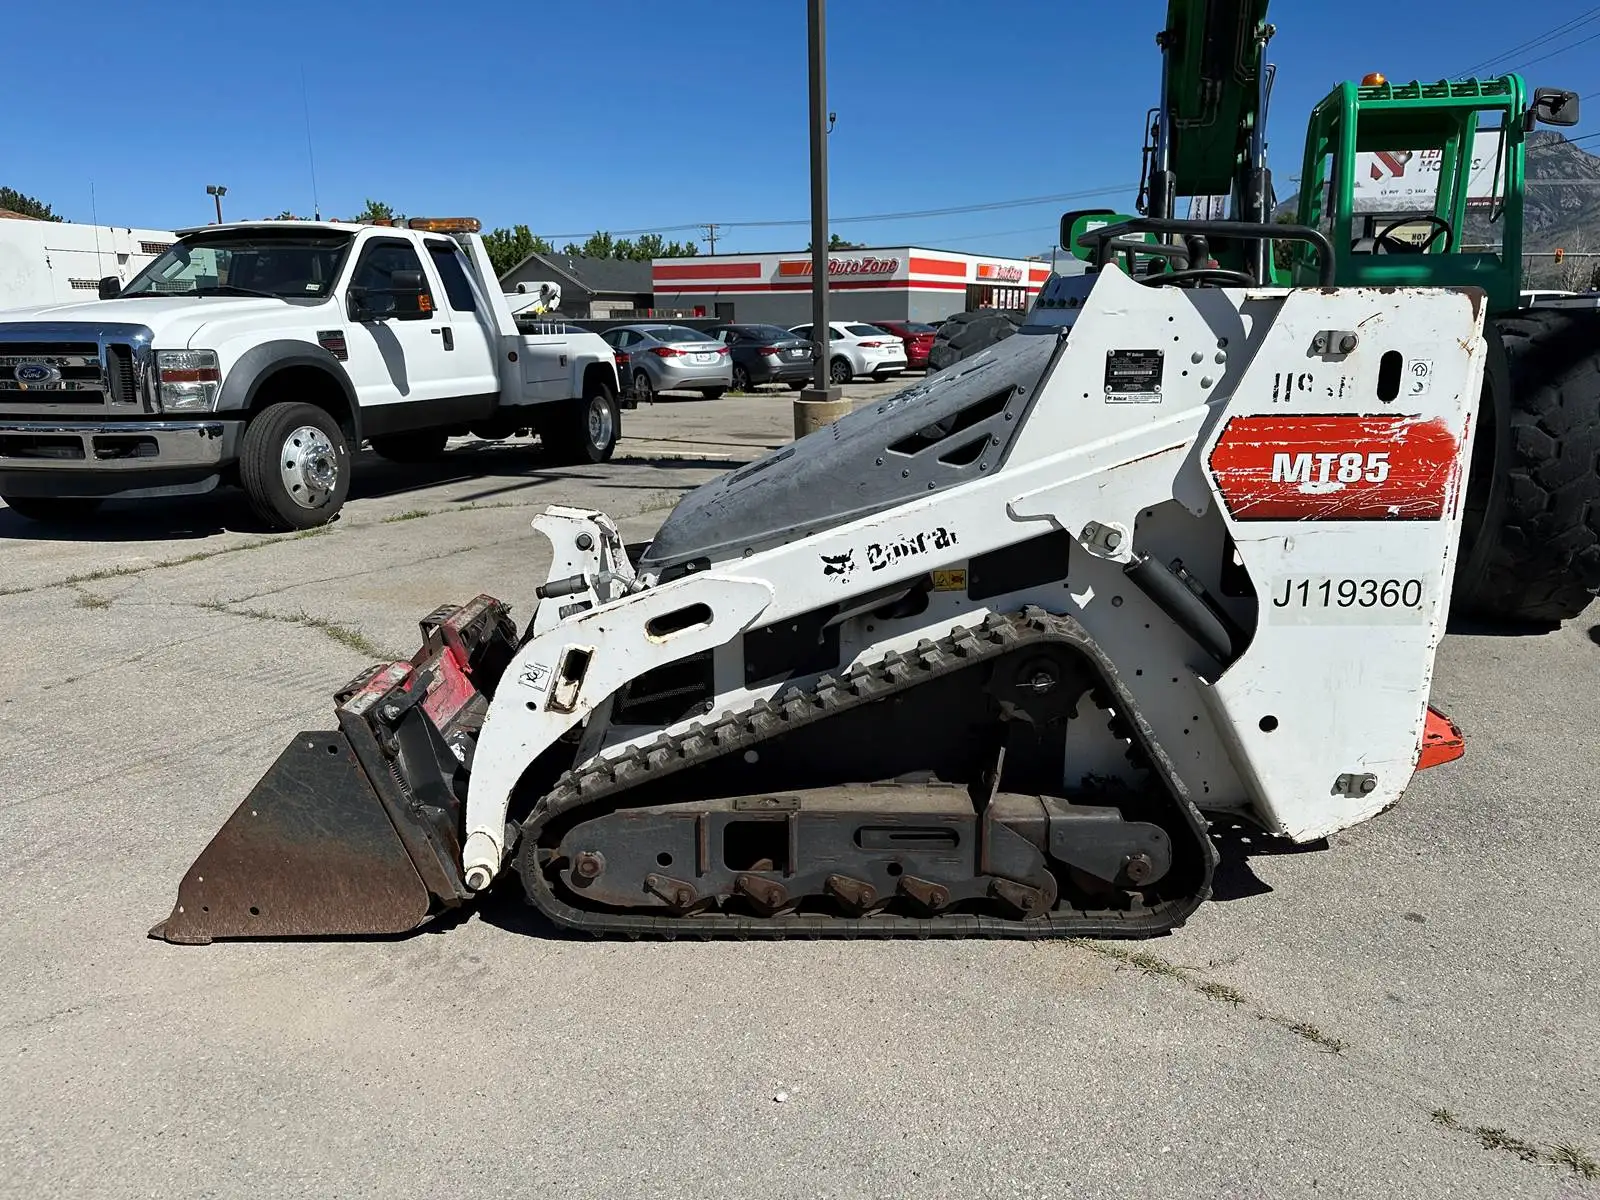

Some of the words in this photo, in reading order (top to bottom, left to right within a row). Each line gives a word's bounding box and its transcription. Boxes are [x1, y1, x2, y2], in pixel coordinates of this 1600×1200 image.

[828, 257, 899, 275] AutoZone
[1271, 452, 1391, 483] MT85
[1273, 579, 1422, 608] J119360
